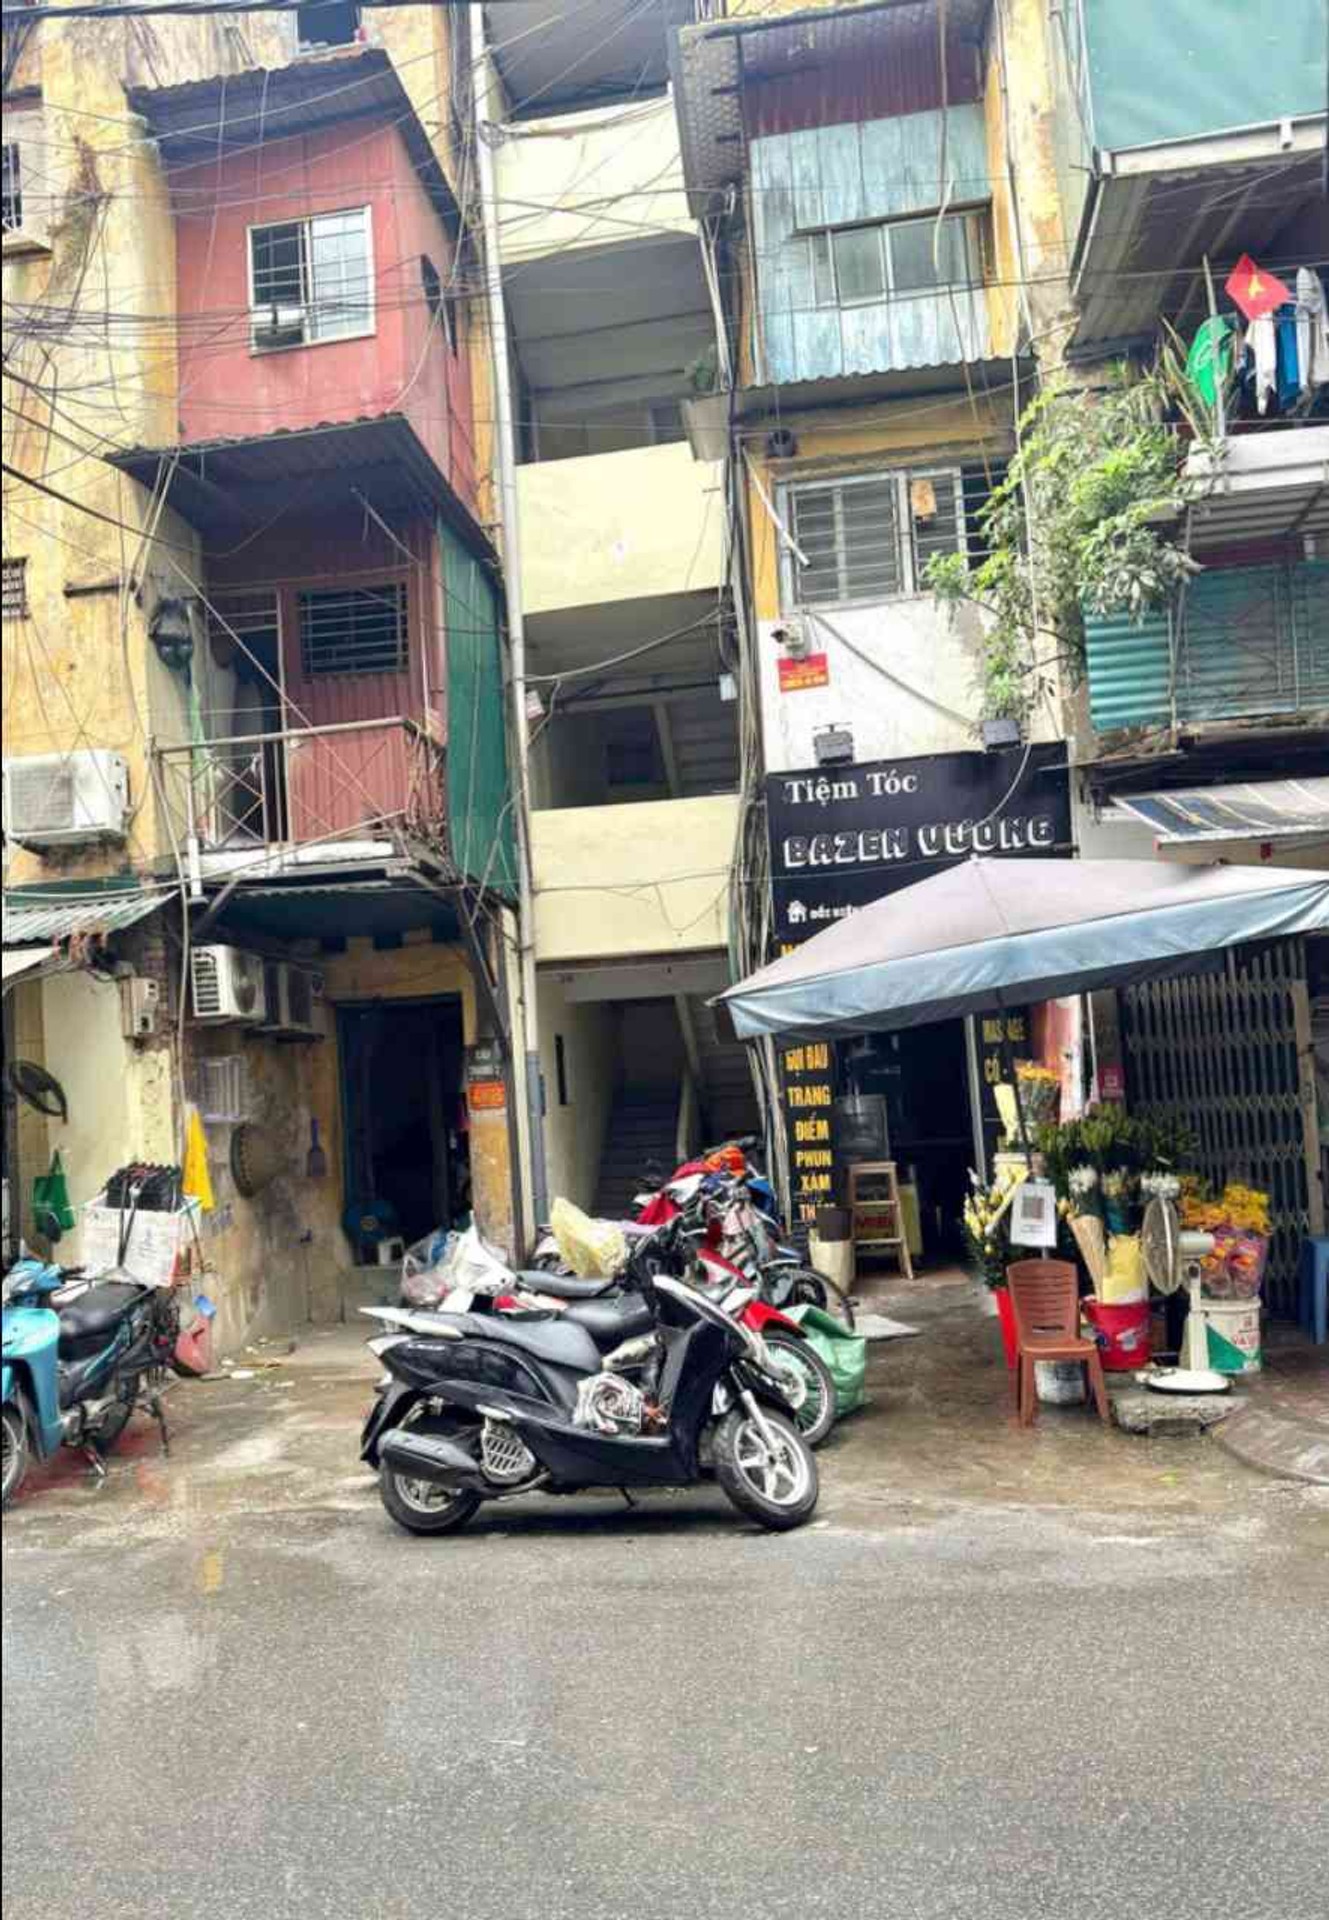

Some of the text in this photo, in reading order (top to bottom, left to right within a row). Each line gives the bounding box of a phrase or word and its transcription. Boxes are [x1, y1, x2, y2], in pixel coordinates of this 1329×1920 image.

[784, 768, 918, 807] Tiệm Tóc
[784, 826, 909, 869] BAZEN
[787, 1085, 832, 1108] TRANG
[795, 1149, 832, 1168] PHUN
